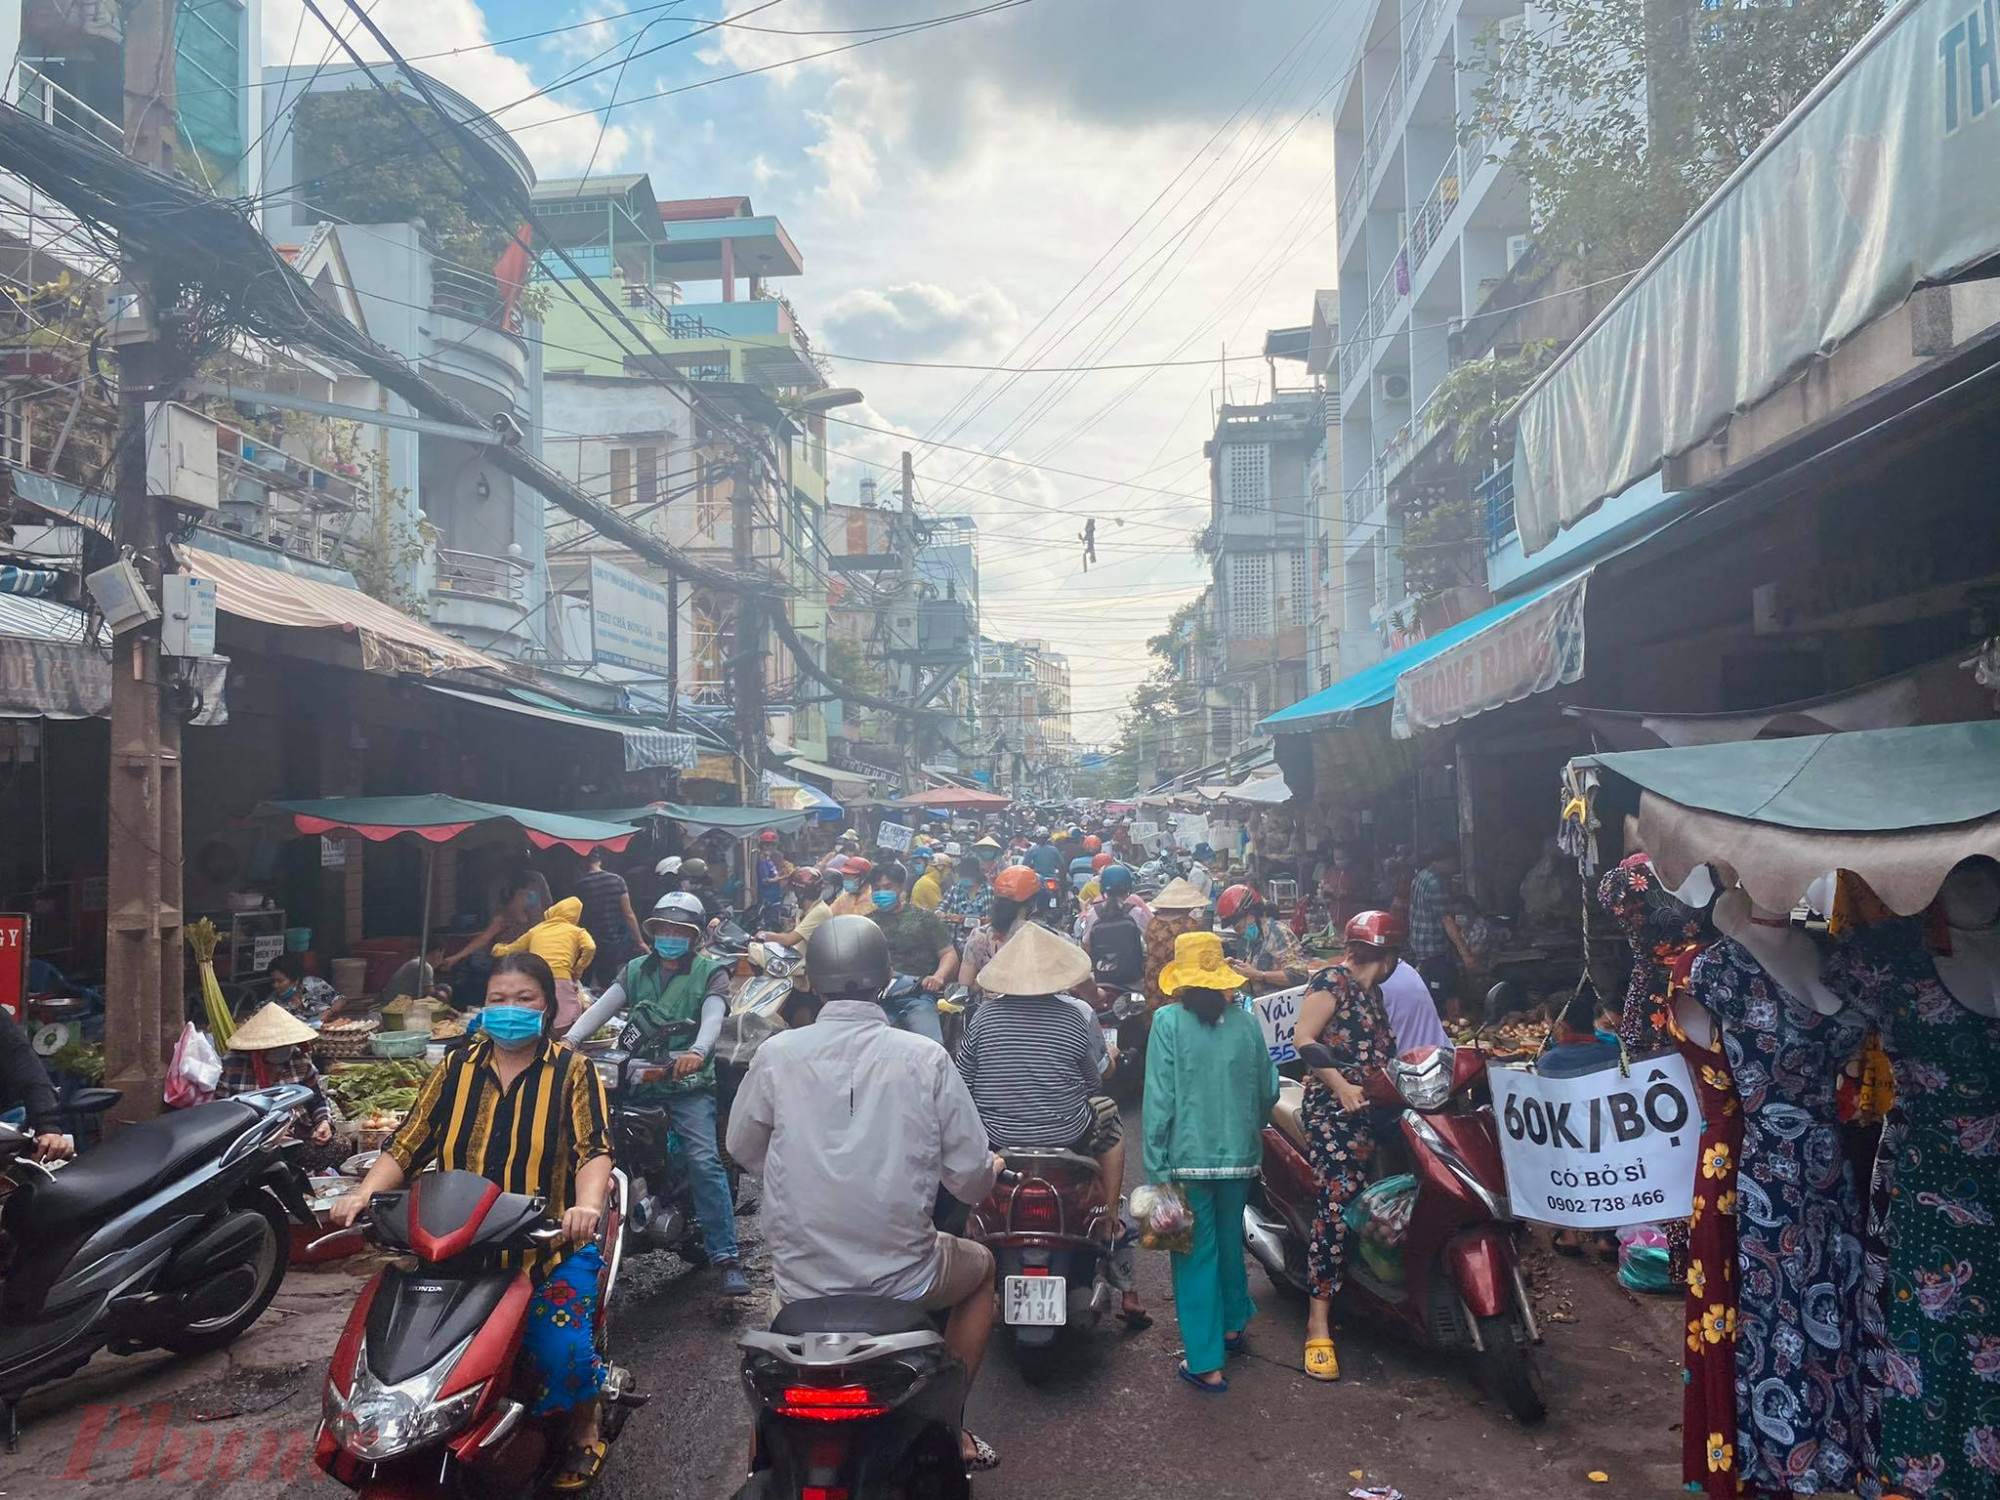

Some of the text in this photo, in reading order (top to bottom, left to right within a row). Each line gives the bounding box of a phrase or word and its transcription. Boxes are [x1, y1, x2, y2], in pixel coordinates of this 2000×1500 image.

[1260, 995, 1294, 1023] Vải
[1504, 1068, 1689, 1154] 60K/BỘ
[1550, 1157, 1647, 1188] CÓ BỎ SỈ
[1547, 1189, 1665, 1213] 0902 738 466
[1013, 1301, 1057, 1321] 7134
